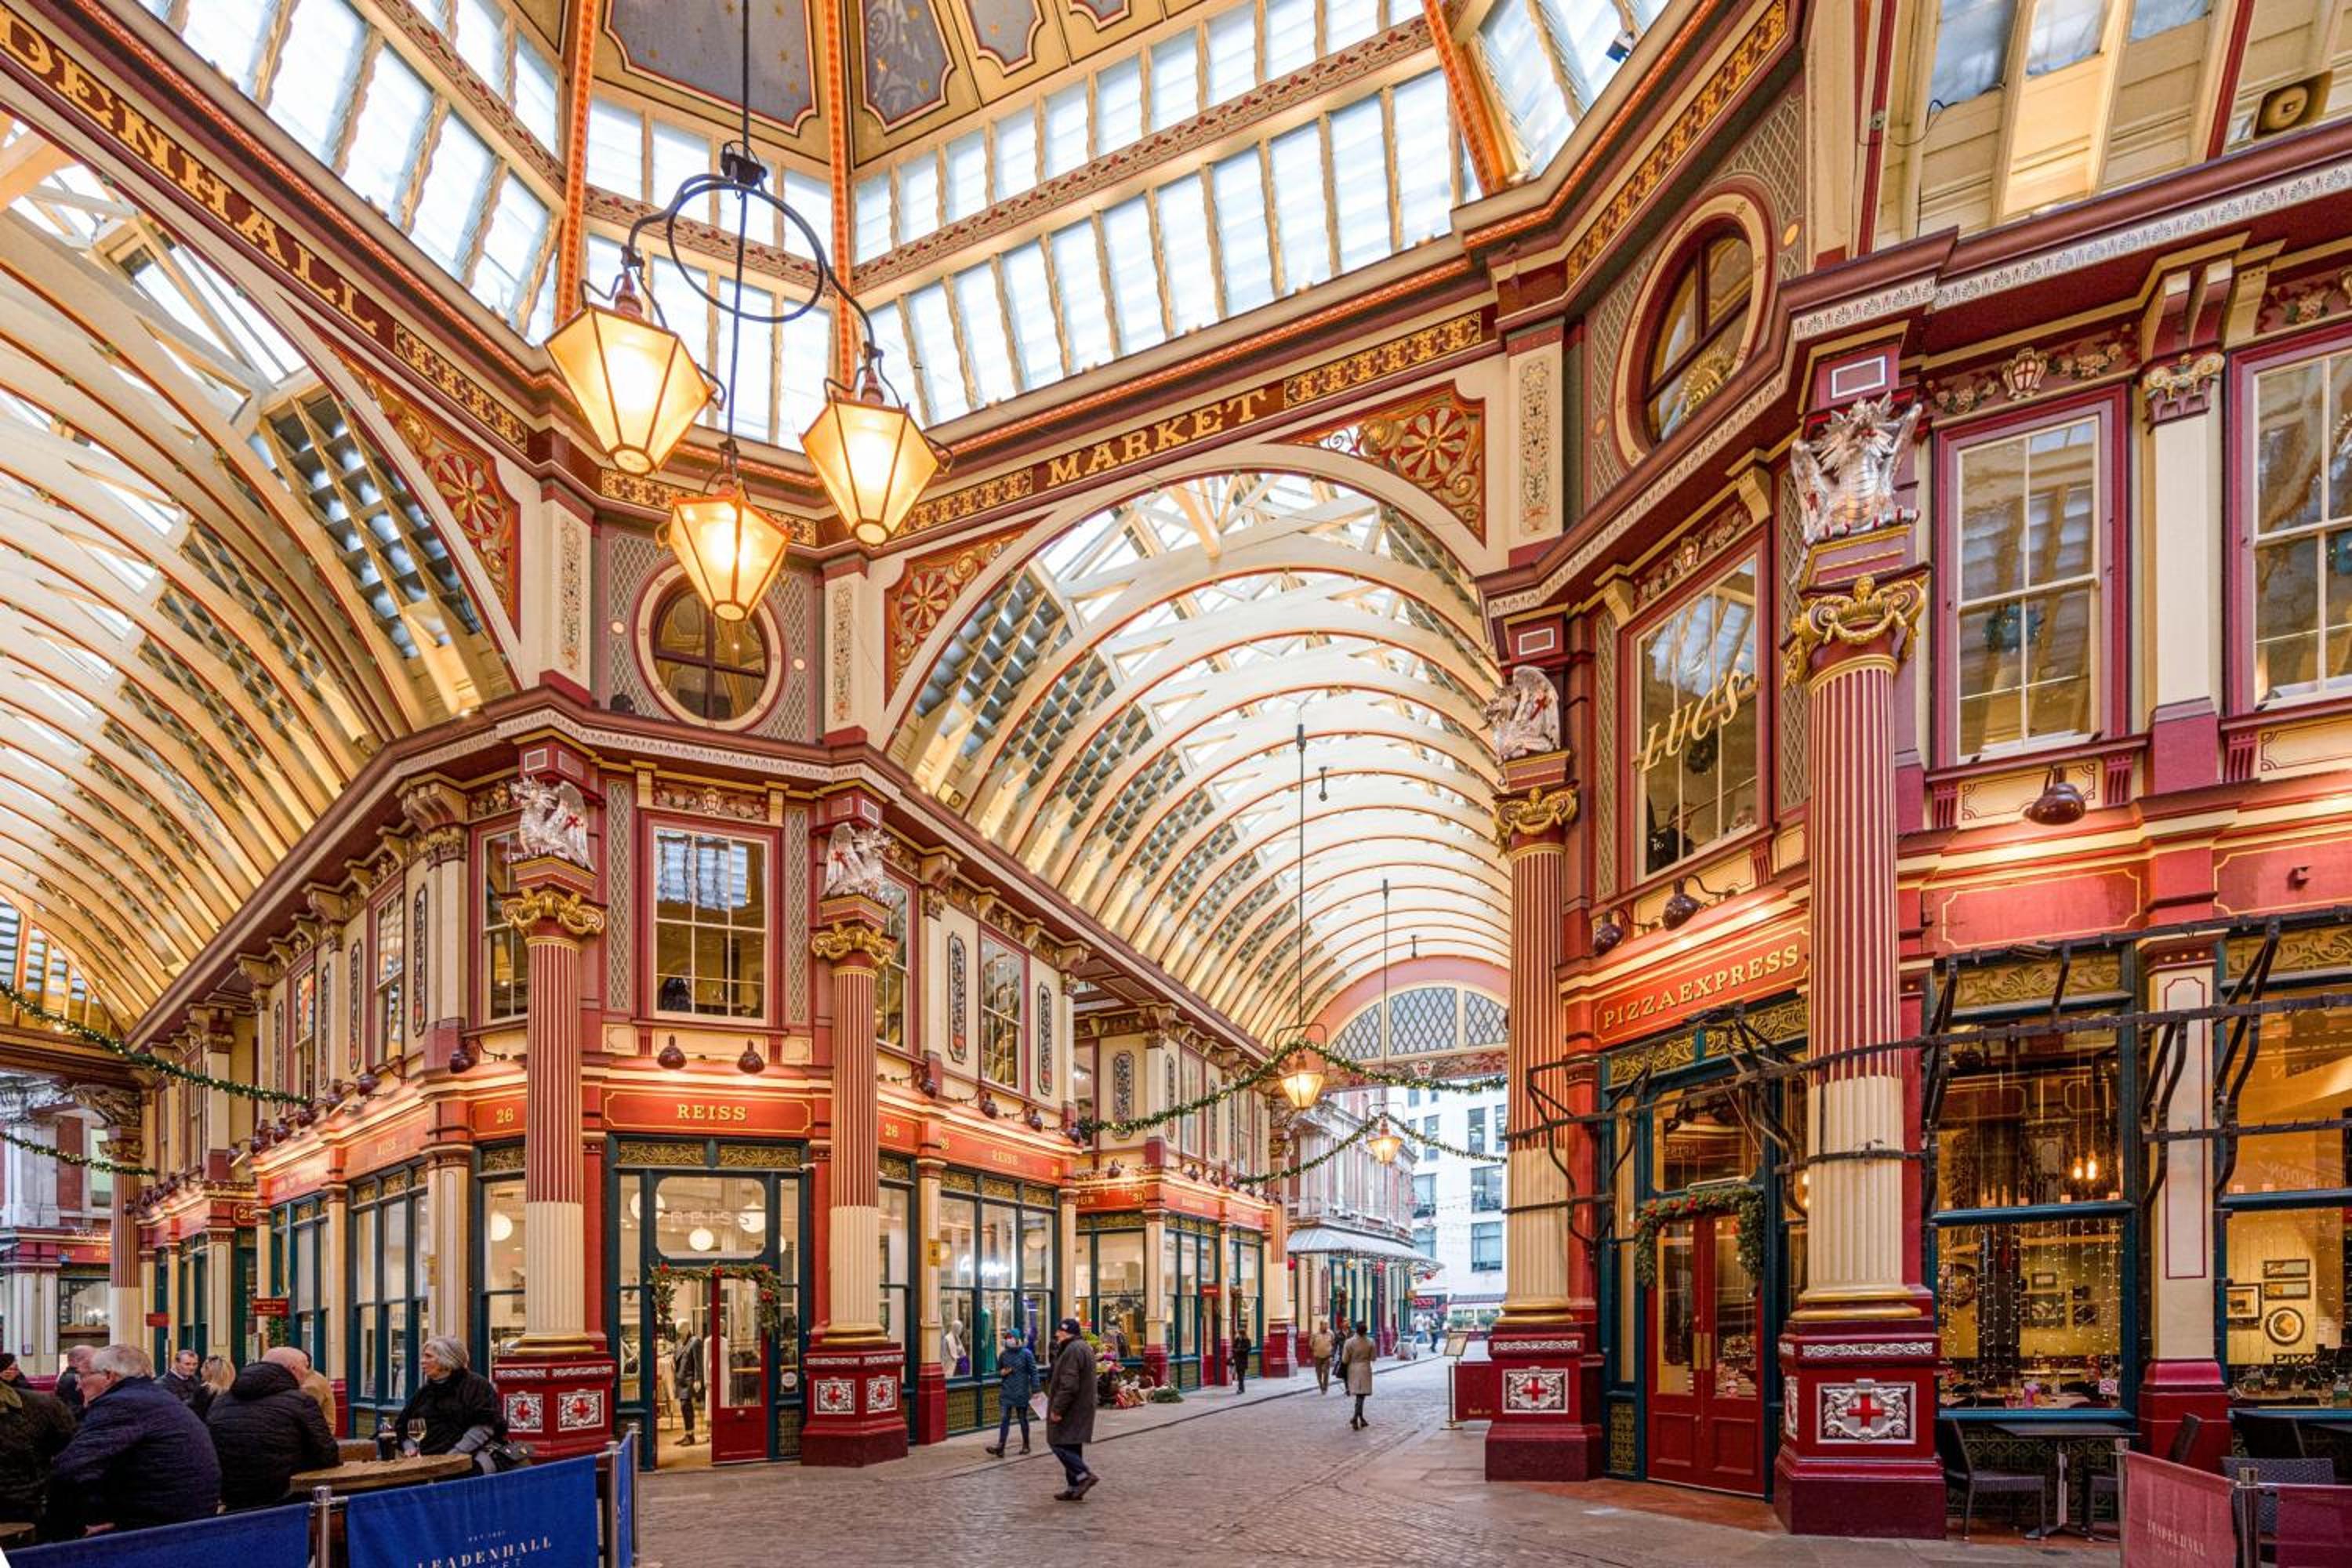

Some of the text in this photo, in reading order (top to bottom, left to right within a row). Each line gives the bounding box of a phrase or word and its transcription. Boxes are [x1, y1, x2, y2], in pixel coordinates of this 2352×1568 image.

[0, 3, 378, 336] DENHALL
[1047, 389, 1266, 487] MARKET
[1603, 944, 1798, 1029] PIZZAEXPRESS
[496, 1108, 514, 1123] 26
[677, 1103, 747, 1120] REISS
[885, 1122, 898, 1138] 26
